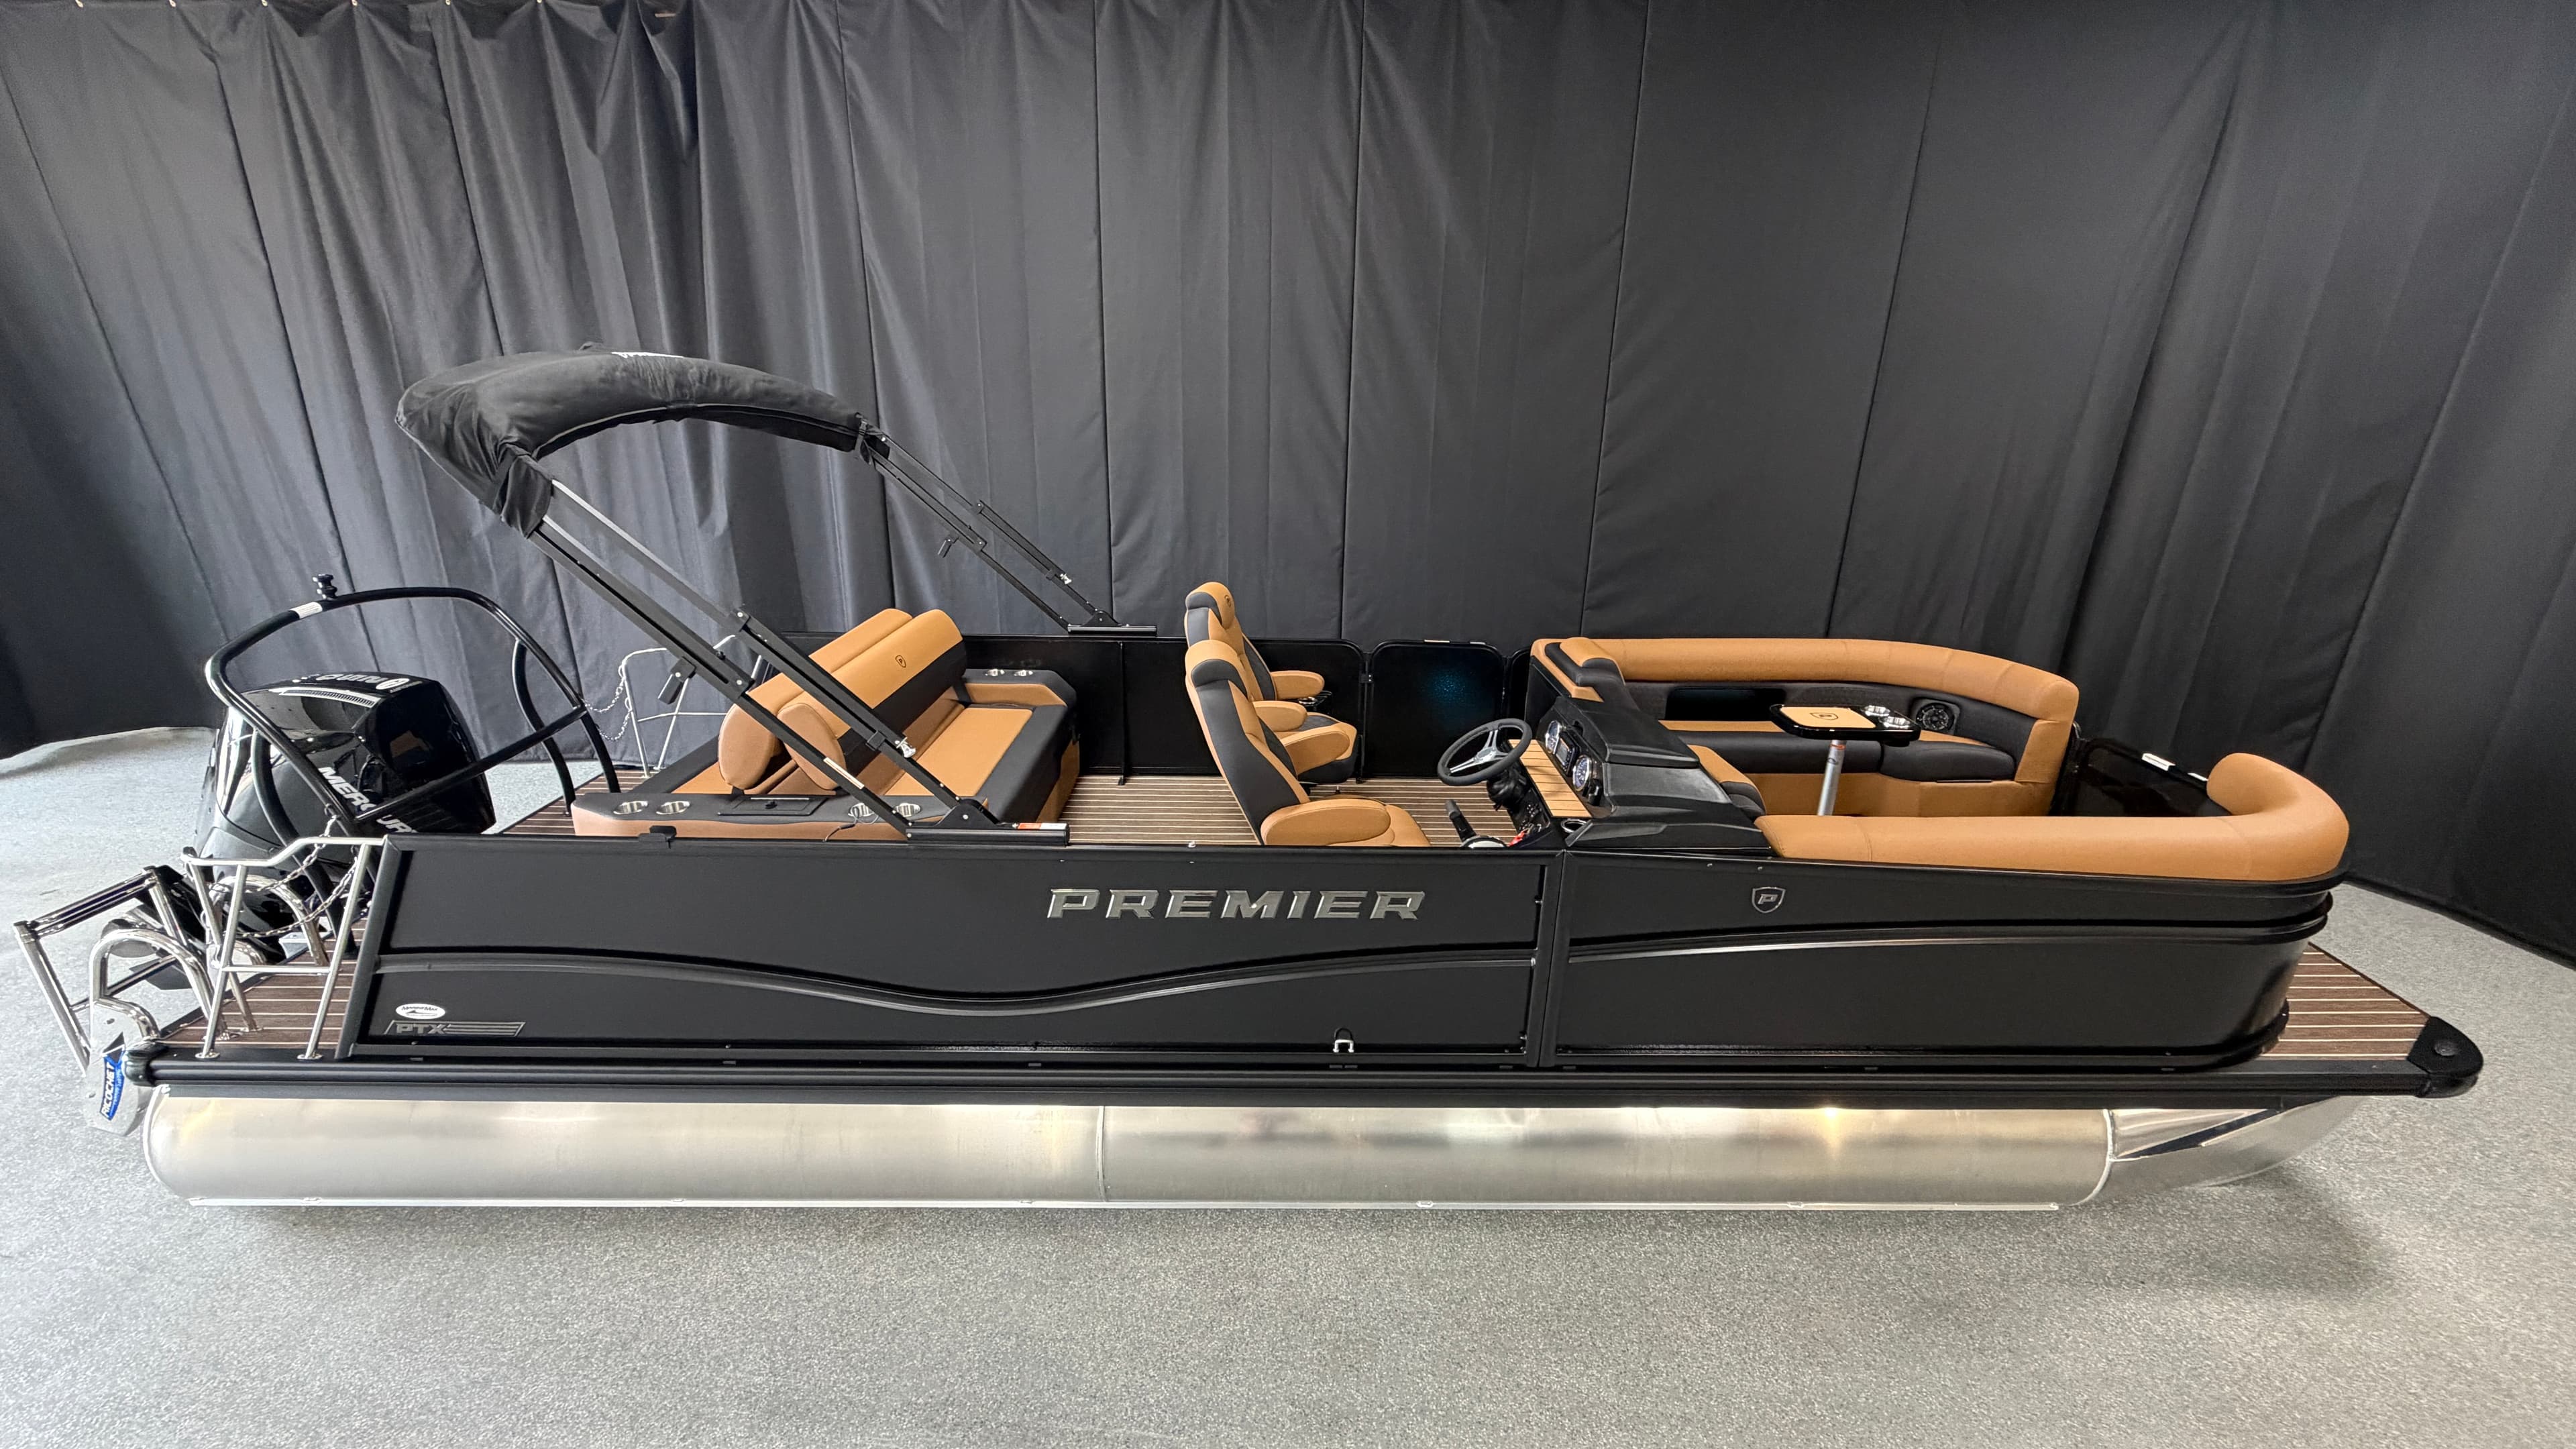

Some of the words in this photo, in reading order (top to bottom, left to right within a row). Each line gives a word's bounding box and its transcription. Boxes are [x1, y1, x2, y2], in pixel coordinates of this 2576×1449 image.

[318, 767, 419, 833] MERCUR
[1046, 889, 1426, 920] PREMIER
[396, 1023, 446, 1034] PTX
[101, 1061, 115, 1118] RICOCHET
